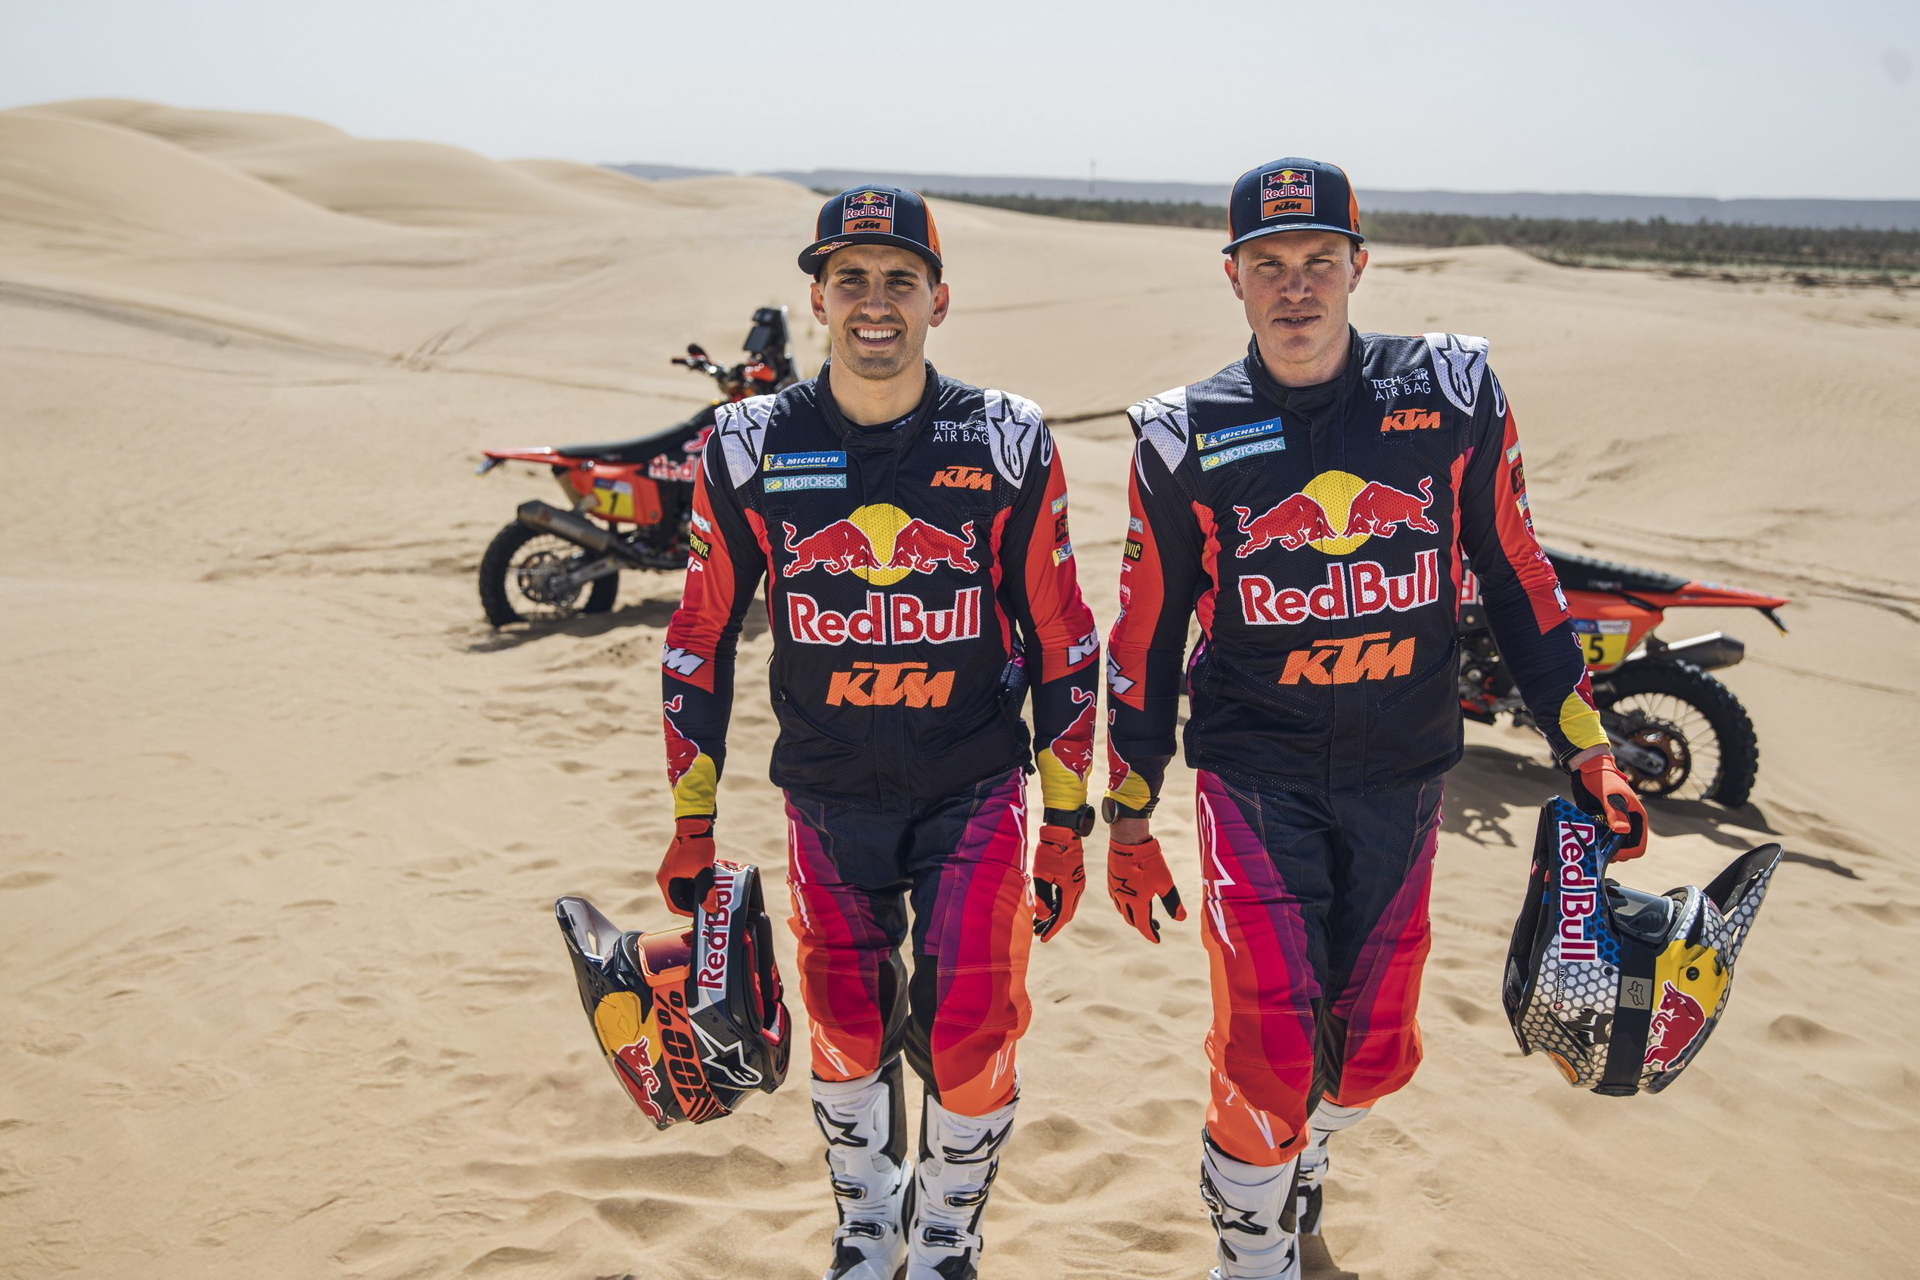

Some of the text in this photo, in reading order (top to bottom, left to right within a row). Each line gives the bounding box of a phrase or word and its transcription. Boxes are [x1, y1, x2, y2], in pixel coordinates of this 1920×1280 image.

[1263, 184, 1312, 200] Red Bull
[845, 205, 892, 219] Red Bull
[1273, 201, 1302, 212] KTM
[853, 220, 881, 230] KTM
[1375, 381, 1431, 401] AIR BAG
[1380, 408, 1441, 432] KTM
[932, 430, 990, 445] AIR BAG
[1220, 424, 1274, 441] MICHELIN
[786, 456, 839, 465] MICHELIN
[1220, 439, 1282, 462] MOTOREX
[783, 476, 844, 489] MOTOREX
[930, 465, 994, 491] KTM
[1238, 562, 1349, 626] Red
[1349, 548, 1439, 617] Bull
[786, 586, 982, 646] Red Bull
[1277, 631, 1416, 685] KTM
[1588, 634, 1605, 664] 5
[825, 661, 956, 709] KTM
[1558, 821, 1598, 963] Red Bull
[697, 875, 734, 991] Red Bull
[655, 990, 712, 1102] 100%
